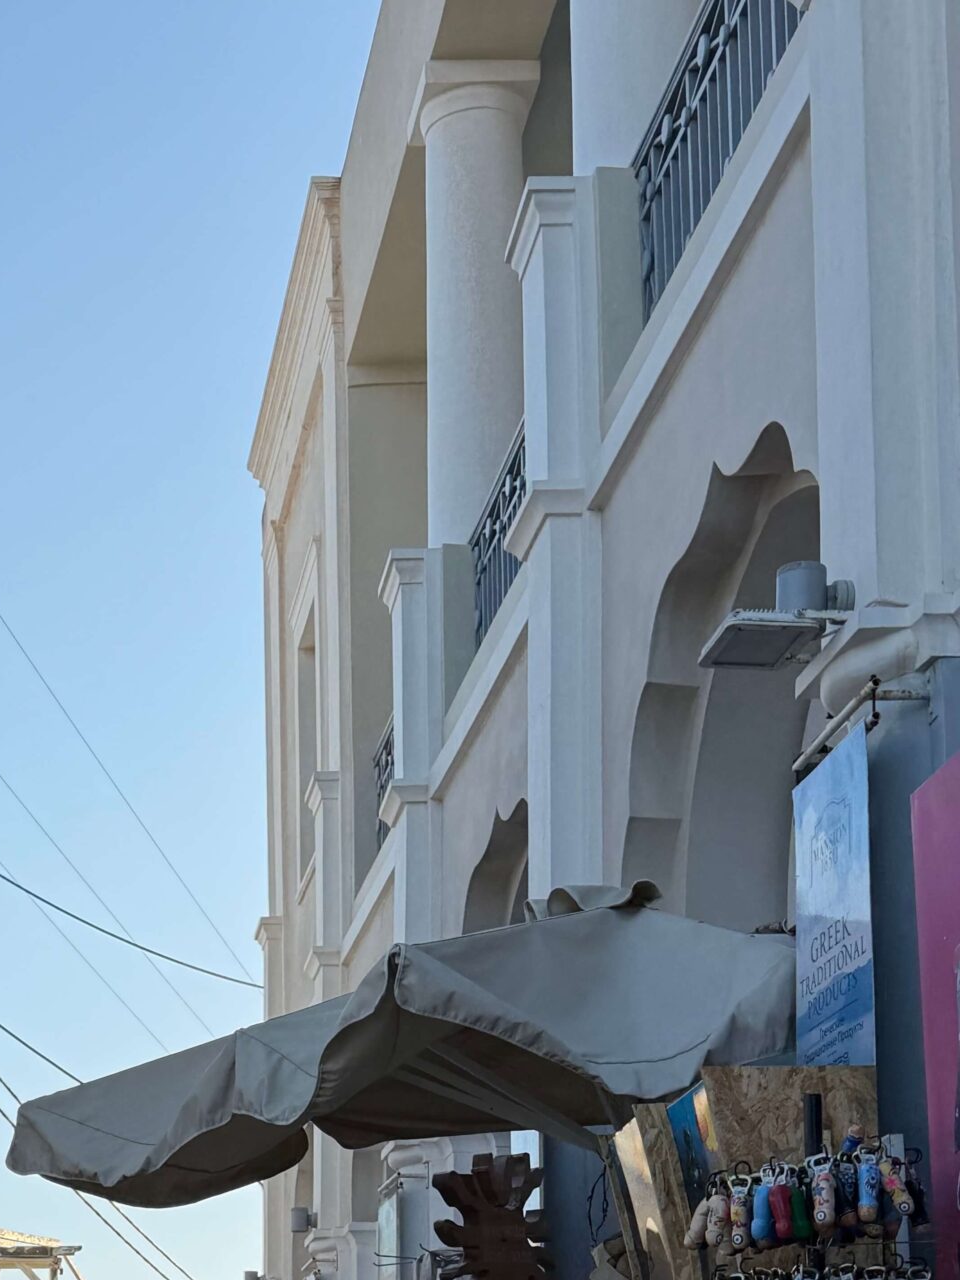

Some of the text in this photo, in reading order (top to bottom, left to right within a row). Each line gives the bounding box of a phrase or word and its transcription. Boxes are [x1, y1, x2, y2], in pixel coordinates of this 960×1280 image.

[810, 916, 851, 963] GREEK
[799, 935, 867, 998] TRADITIONAL
[807, 969, 858, 1019] PRODUCTS
